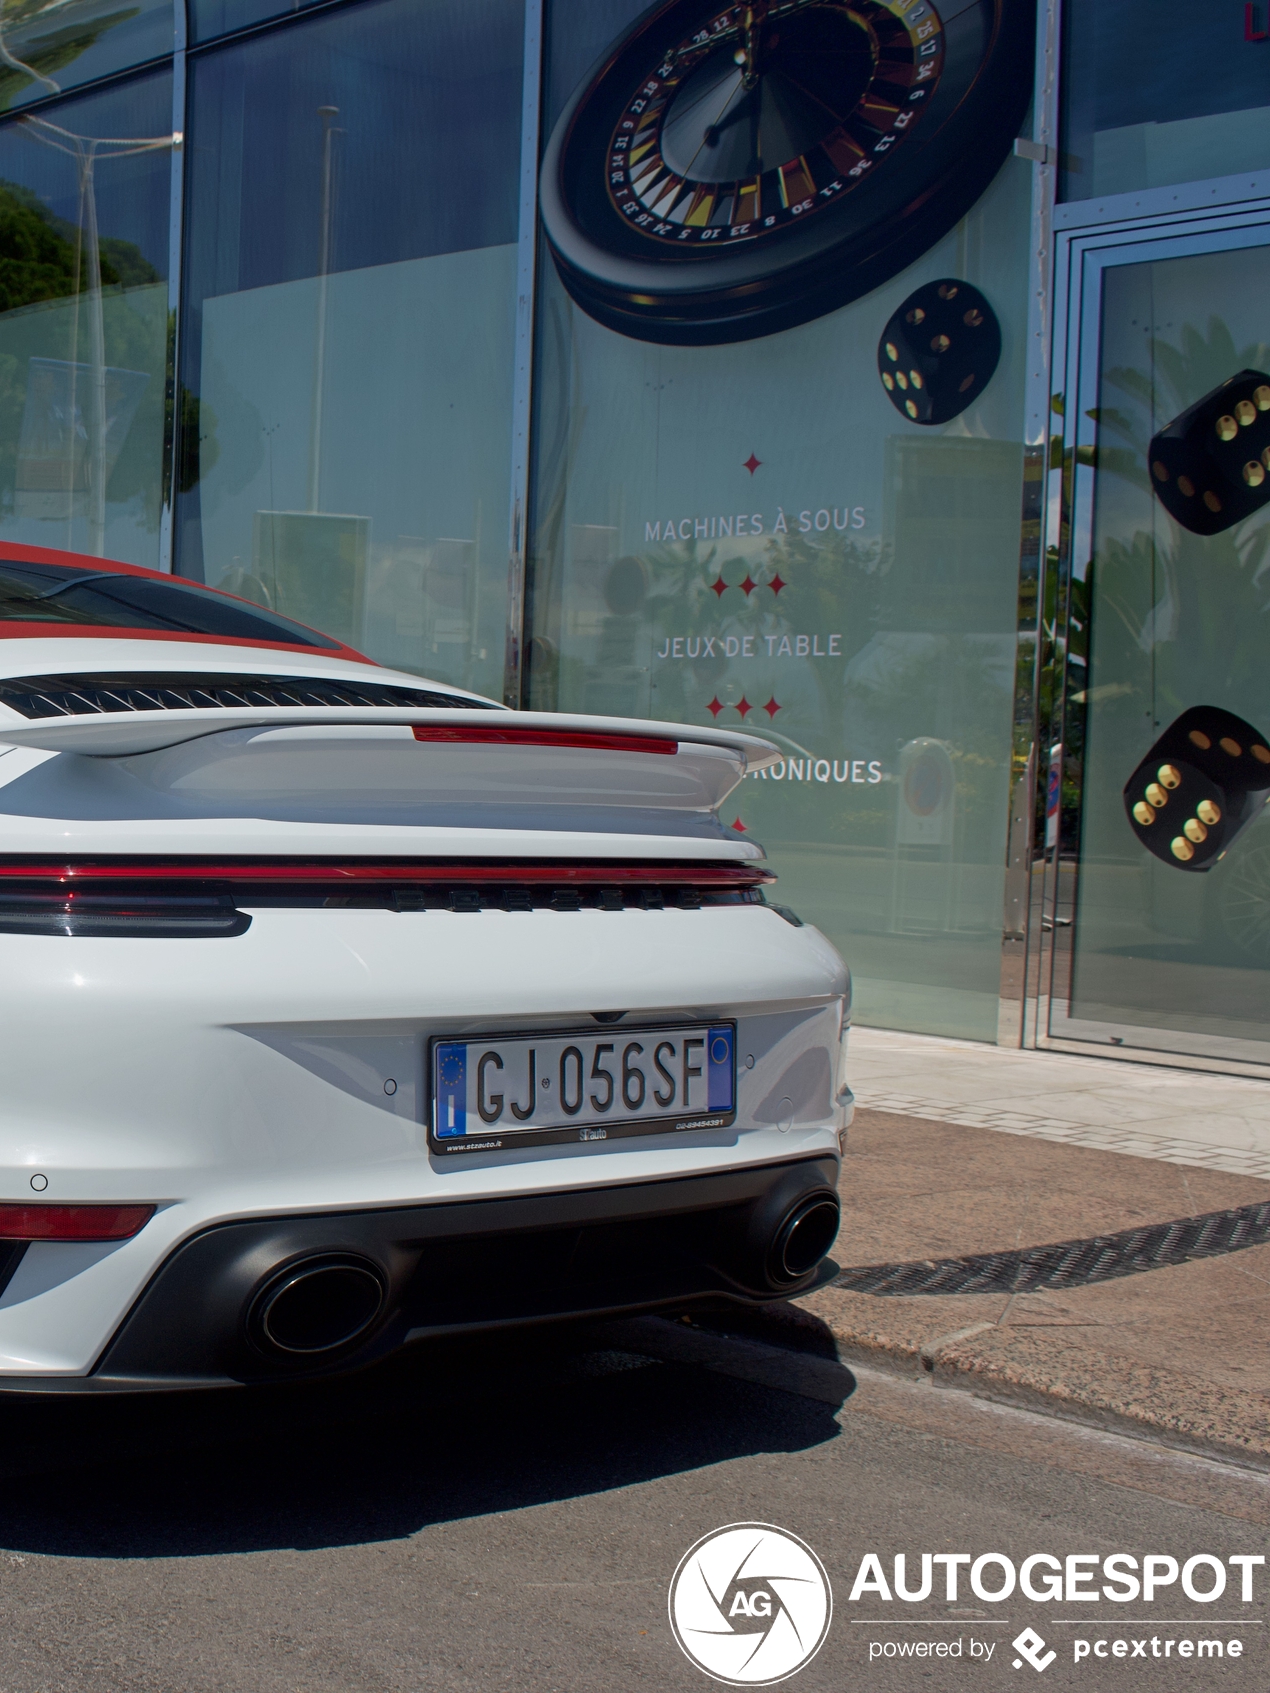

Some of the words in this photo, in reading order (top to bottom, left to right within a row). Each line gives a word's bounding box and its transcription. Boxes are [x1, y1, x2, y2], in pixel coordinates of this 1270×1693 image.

[713, 16, 729, 32] 12
[916, 20, 934, 39] 25
[1244, 1, 1270, 42] L
[920, 39, 936, 56] 17
[916, 60, 934, 80] 34
[643, 81, 658, 96] 18
[631, 99, 647, 113] 22
[893, 110, 914, 128] 27
[615, 135, 629, 149] 31
[874, 135, 896, 152] 13
[612, 154, 624, 167] 14
[849, 159, 872, 176] 36
[612, 171, 624, 183] 20
[819, 180, 843, 197] 11
[623, 201, 639, 215] 33
[791, 199, 813, 215] 30
[635, 213, 654, 226] 16
[764, 215, 776, 227] 8
[652, 223, 673, 235] 24
[700, 228, 722, 239] 10
[730, 224, 751, 236] 23
[644, 513, 764, 542] MACHINES
[773, 506, 788, 534] À
[798, 506, 866, 533] SOUS
[657, 636, 716, 659] JEUX
[725, 635, 755, 657] DE
[764, 634, 842, 657] TABLE
[477, 1049, 536, 1123] GJ
[559, 1038, 705, 1115] 056SF
[446, 1139, 503, 1152] www.stzauto.it
